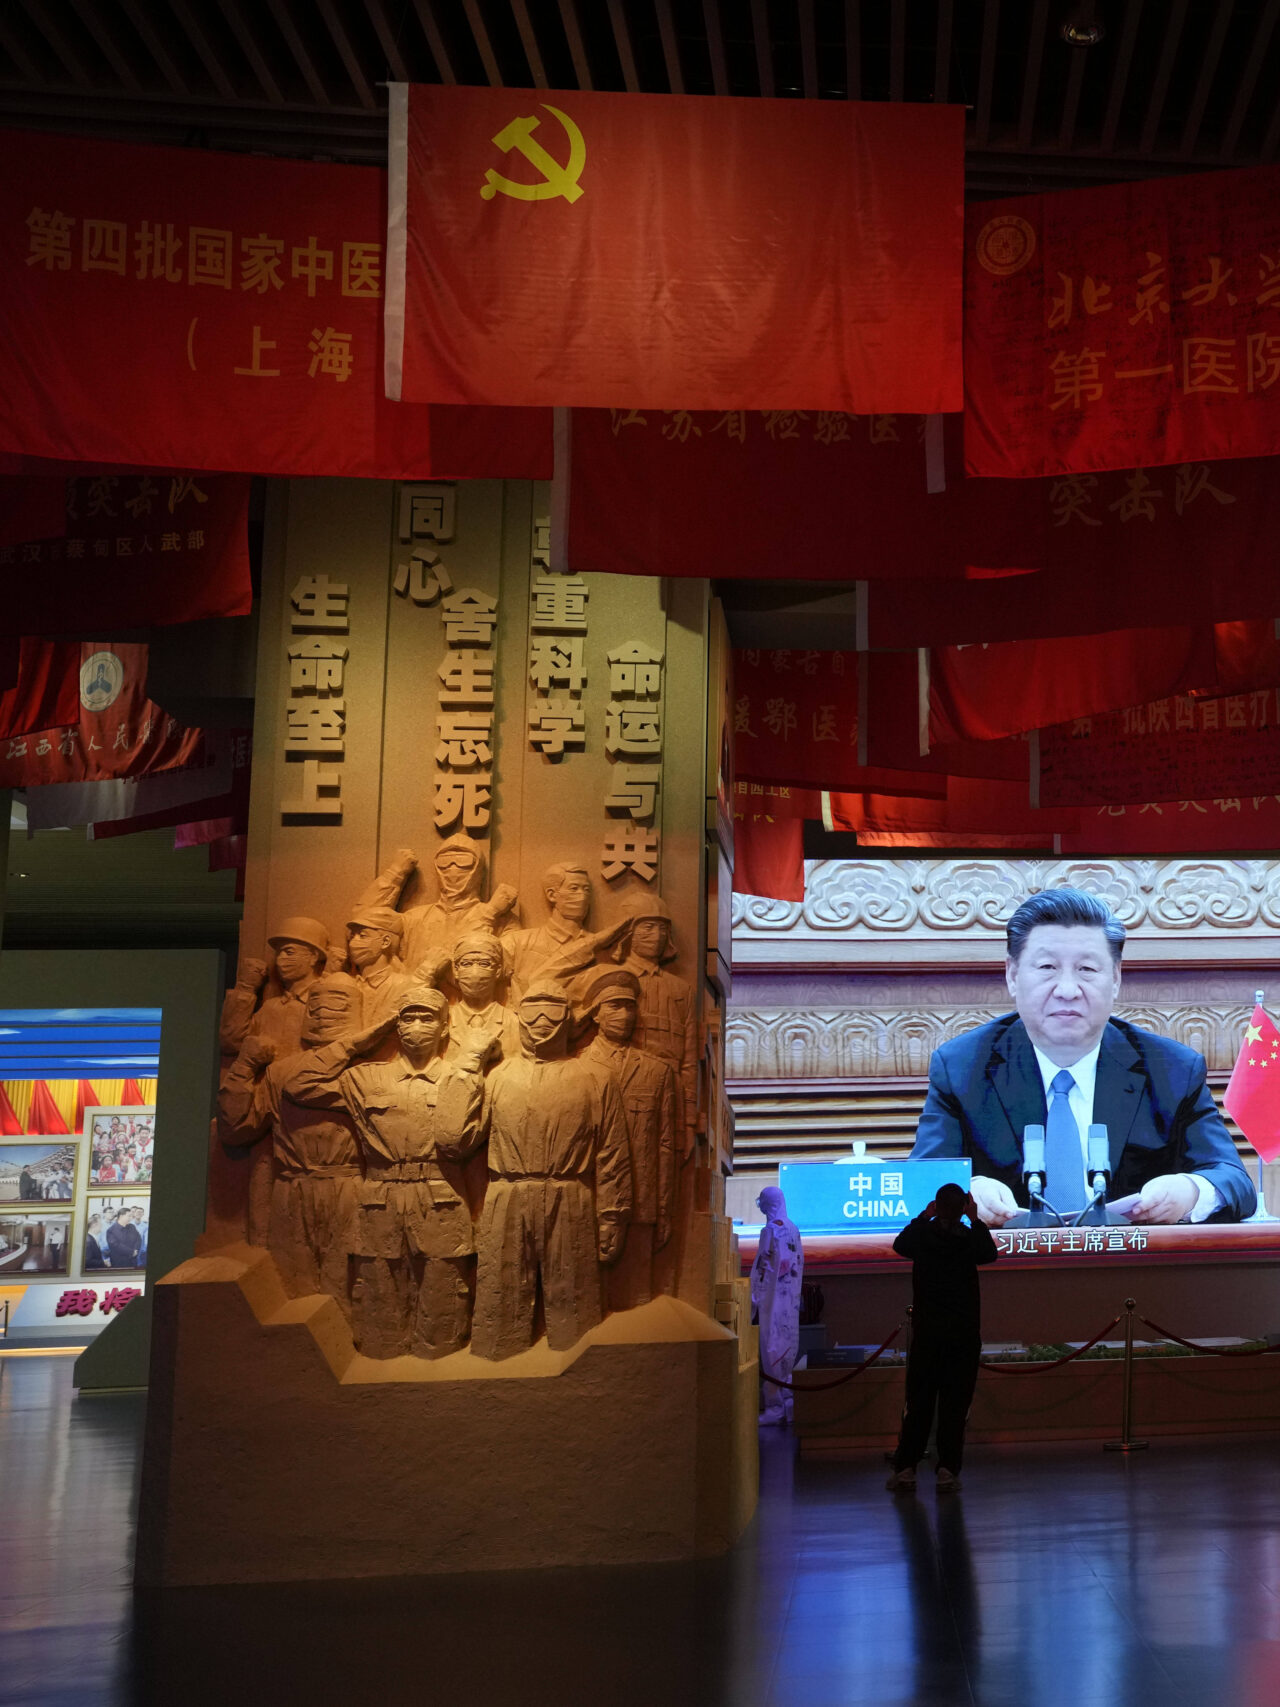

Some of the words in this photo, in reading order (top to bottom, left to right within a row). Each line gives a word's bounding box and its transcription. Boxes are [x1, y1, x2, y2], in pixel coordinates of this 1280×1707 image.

[24, 205, 384, 300] 第四批国家中医
[611, 409, 927, 446] 江苏省检验医
[393, 480, 457, 604] 同心
[281, 573, 350, 824] 生命至上
[432, 587, 499, 838] 舍生忘死
[735, 694, 858, 746] 援鄂医
[601, 639, 665, 883] 命运与共
[842, 1199, 910, 1218] CHINA
[848, 1171, 904, 1197] 中国
[996, 1229, 1149, 1255] 习近平主席宣布
